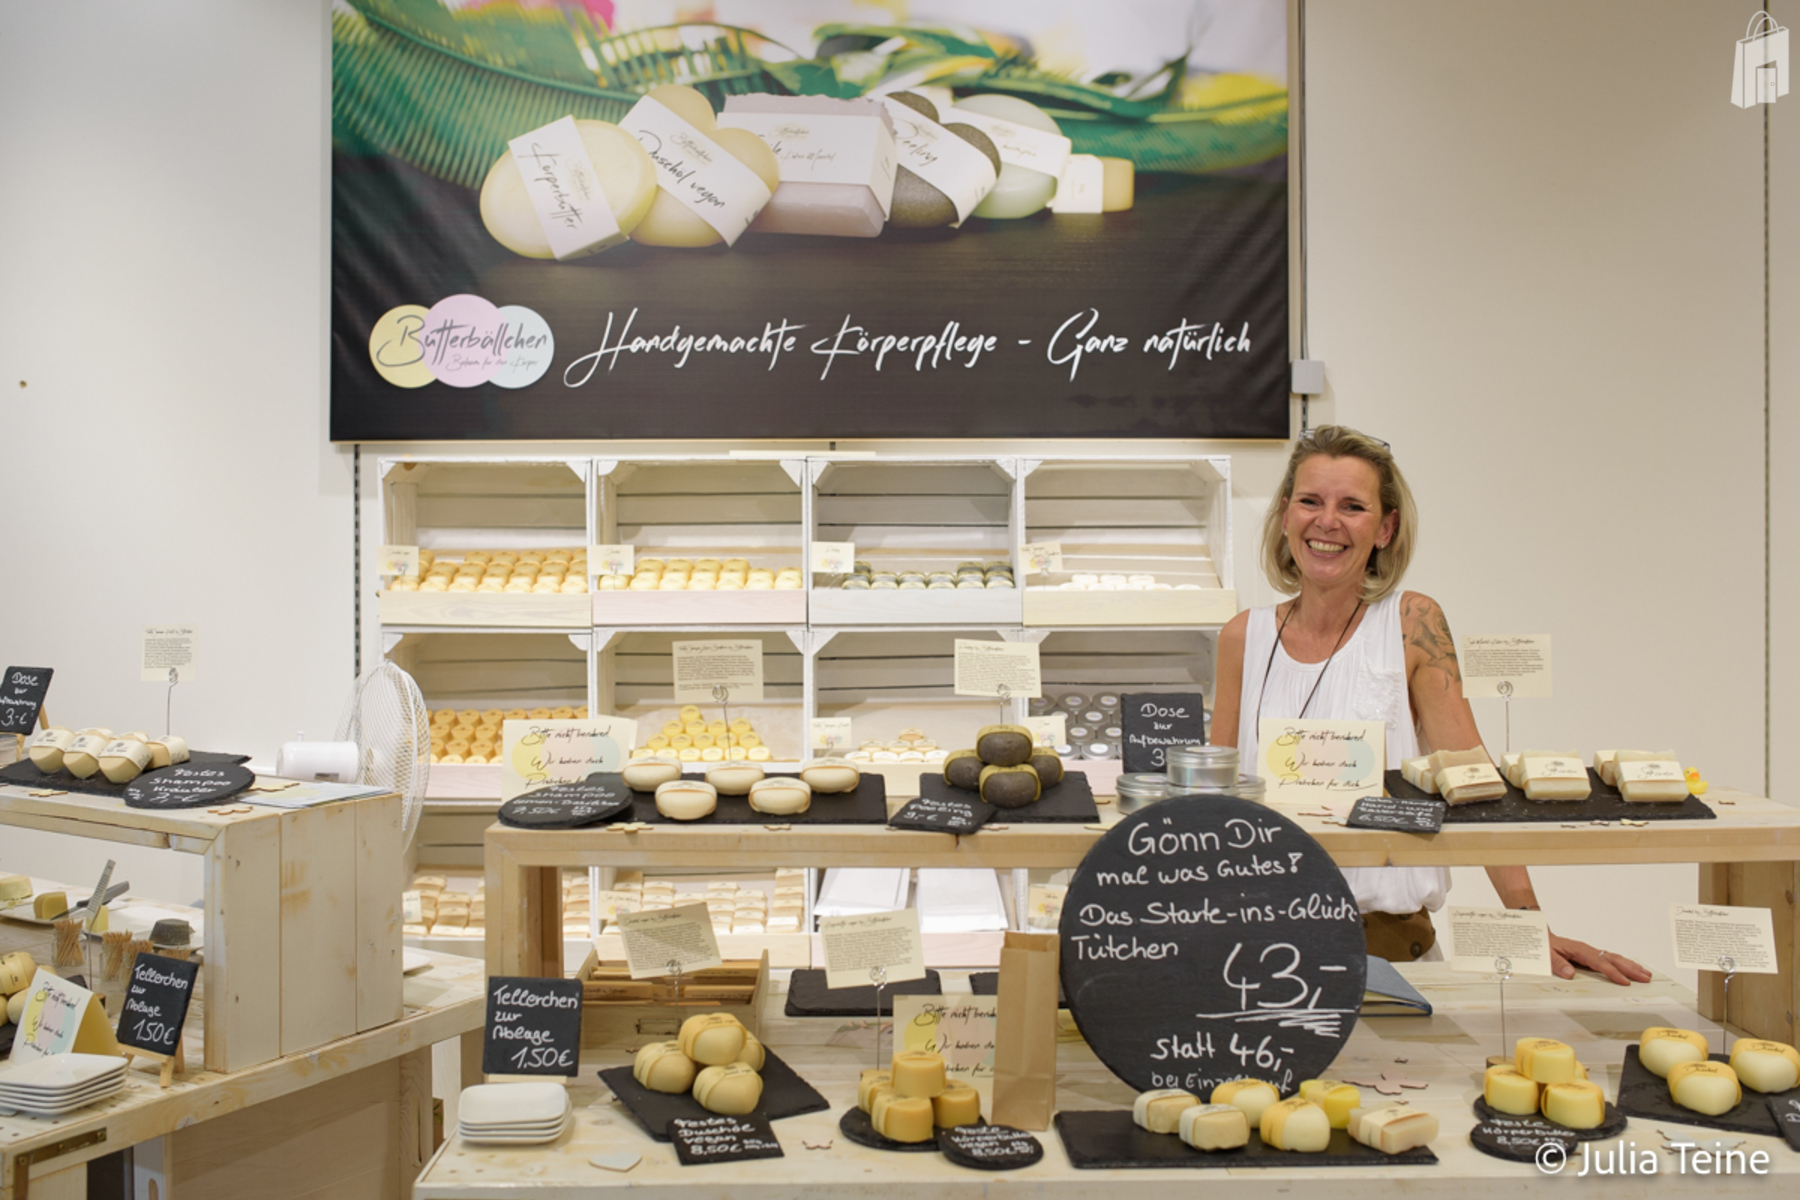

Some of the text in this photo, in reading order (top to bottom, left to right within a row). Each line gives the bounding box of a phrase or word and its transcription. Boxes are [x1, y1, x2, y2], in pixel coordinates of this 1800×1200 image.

[376, 314, 548, 368] Butterbällchen
[564, 307, 1251, 388] Handgemachte Körperpflege - Ganz natürlich
[1140, 702, 1190, 719] Dose
[521, 725, 554, 747] Bitte
[554, 728, 581, 744] nicht
[1153, 721, 1173, 730] zur
[1276, 725, 1309, 747] Bitte
[1308, 730, 1335, 747] nicht
[1284, 752, 1310, 772] Wir
[1128, 817, 1282, 855] Gönn Dir
[1096, 865, 1150, 887] mal
[1157, 865, 1210, 885] was
[1079, 903, 1134, 927] Das
[1070, 932, 1179, 961] Tütchen
[134, 962, 189, 990] Tellerchen
[130, 984, 147, 995] zur
[493, 984, 580, 1010] Tellerchen
[125, 997, 163, 1018] Ablage
[494, 1010, 523, 1023] zur
[913, 1003, 951, 1027] Bitte
[950, 1005, 979, 1026] nicht
[492, 1024, 555, 1046] Ablage
[1151, 1070, 1180, 1089] bei
[682, 1134, 738, 1145] vegan
